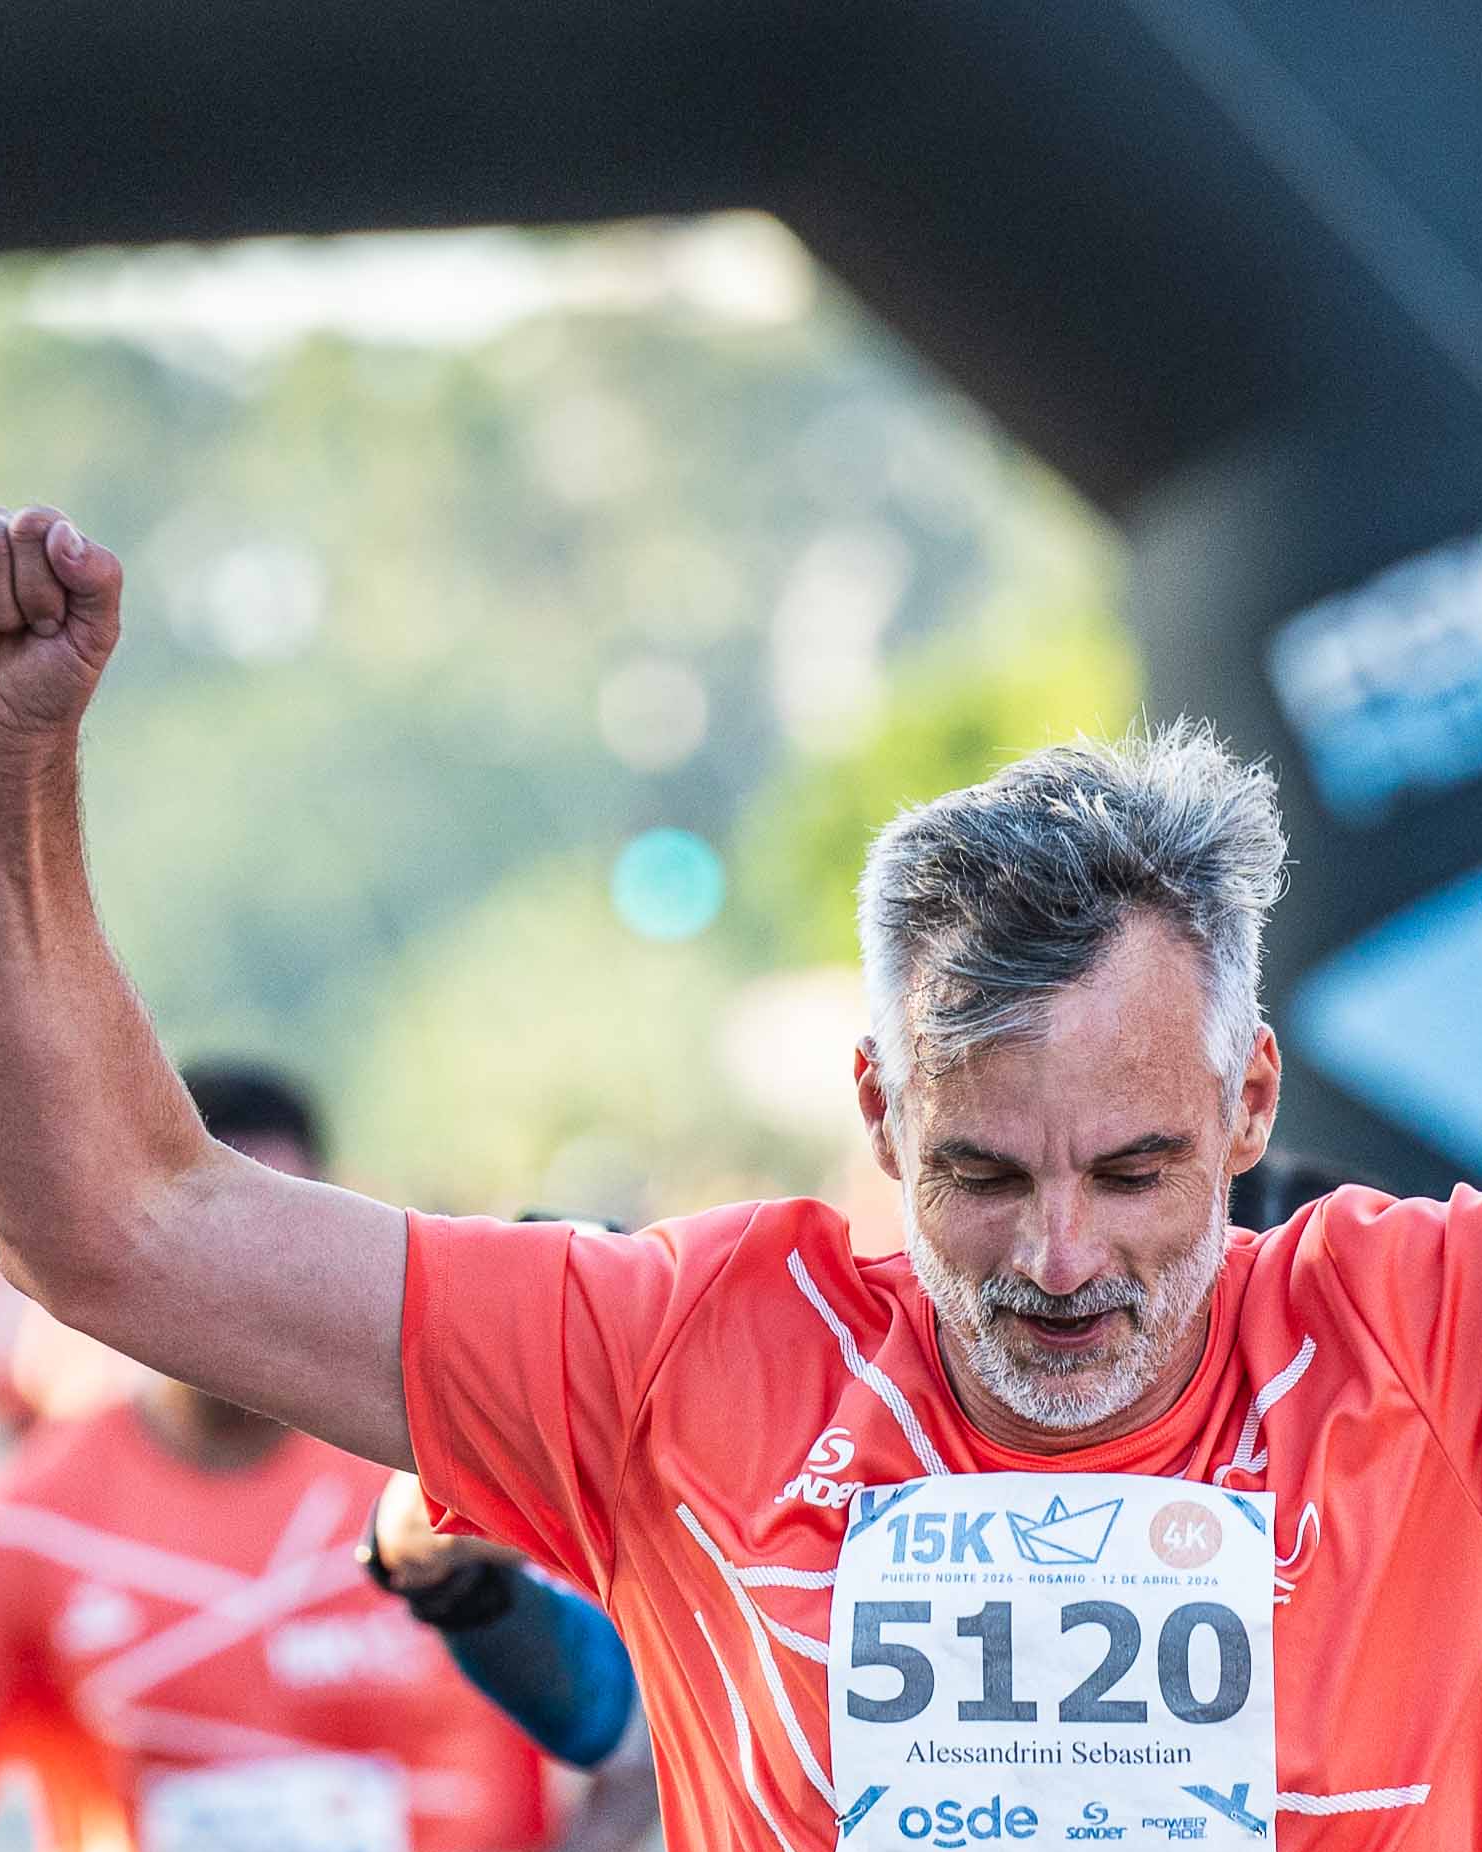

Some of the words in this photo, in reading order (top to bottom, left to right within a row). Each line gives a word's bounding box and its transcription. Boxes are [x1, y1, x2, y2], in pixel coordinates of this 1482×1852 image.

[886, 1511, 996, 1565] 15K
[1163, 1520, 1207, 1549] 4K
[881, 1574, 930, 1584] PUERTO
[936, 1574, 976, 1584] NORTE
[1029, 1575, 1086, 1585] ROSARIO
[1121, 1575, 1137, 1585] DE
[1142, 1575, 1182, 1586] ABRIL
[846, 1600, 1252, 1724] 5120
[906, 1740, 1062, 1764] Alessandrini
[1071, 1741, 1191, 1765] Sebastian
[898, 1794, 1039, 1840] osde
[1141, 1816, 1207, 1829] POWER
